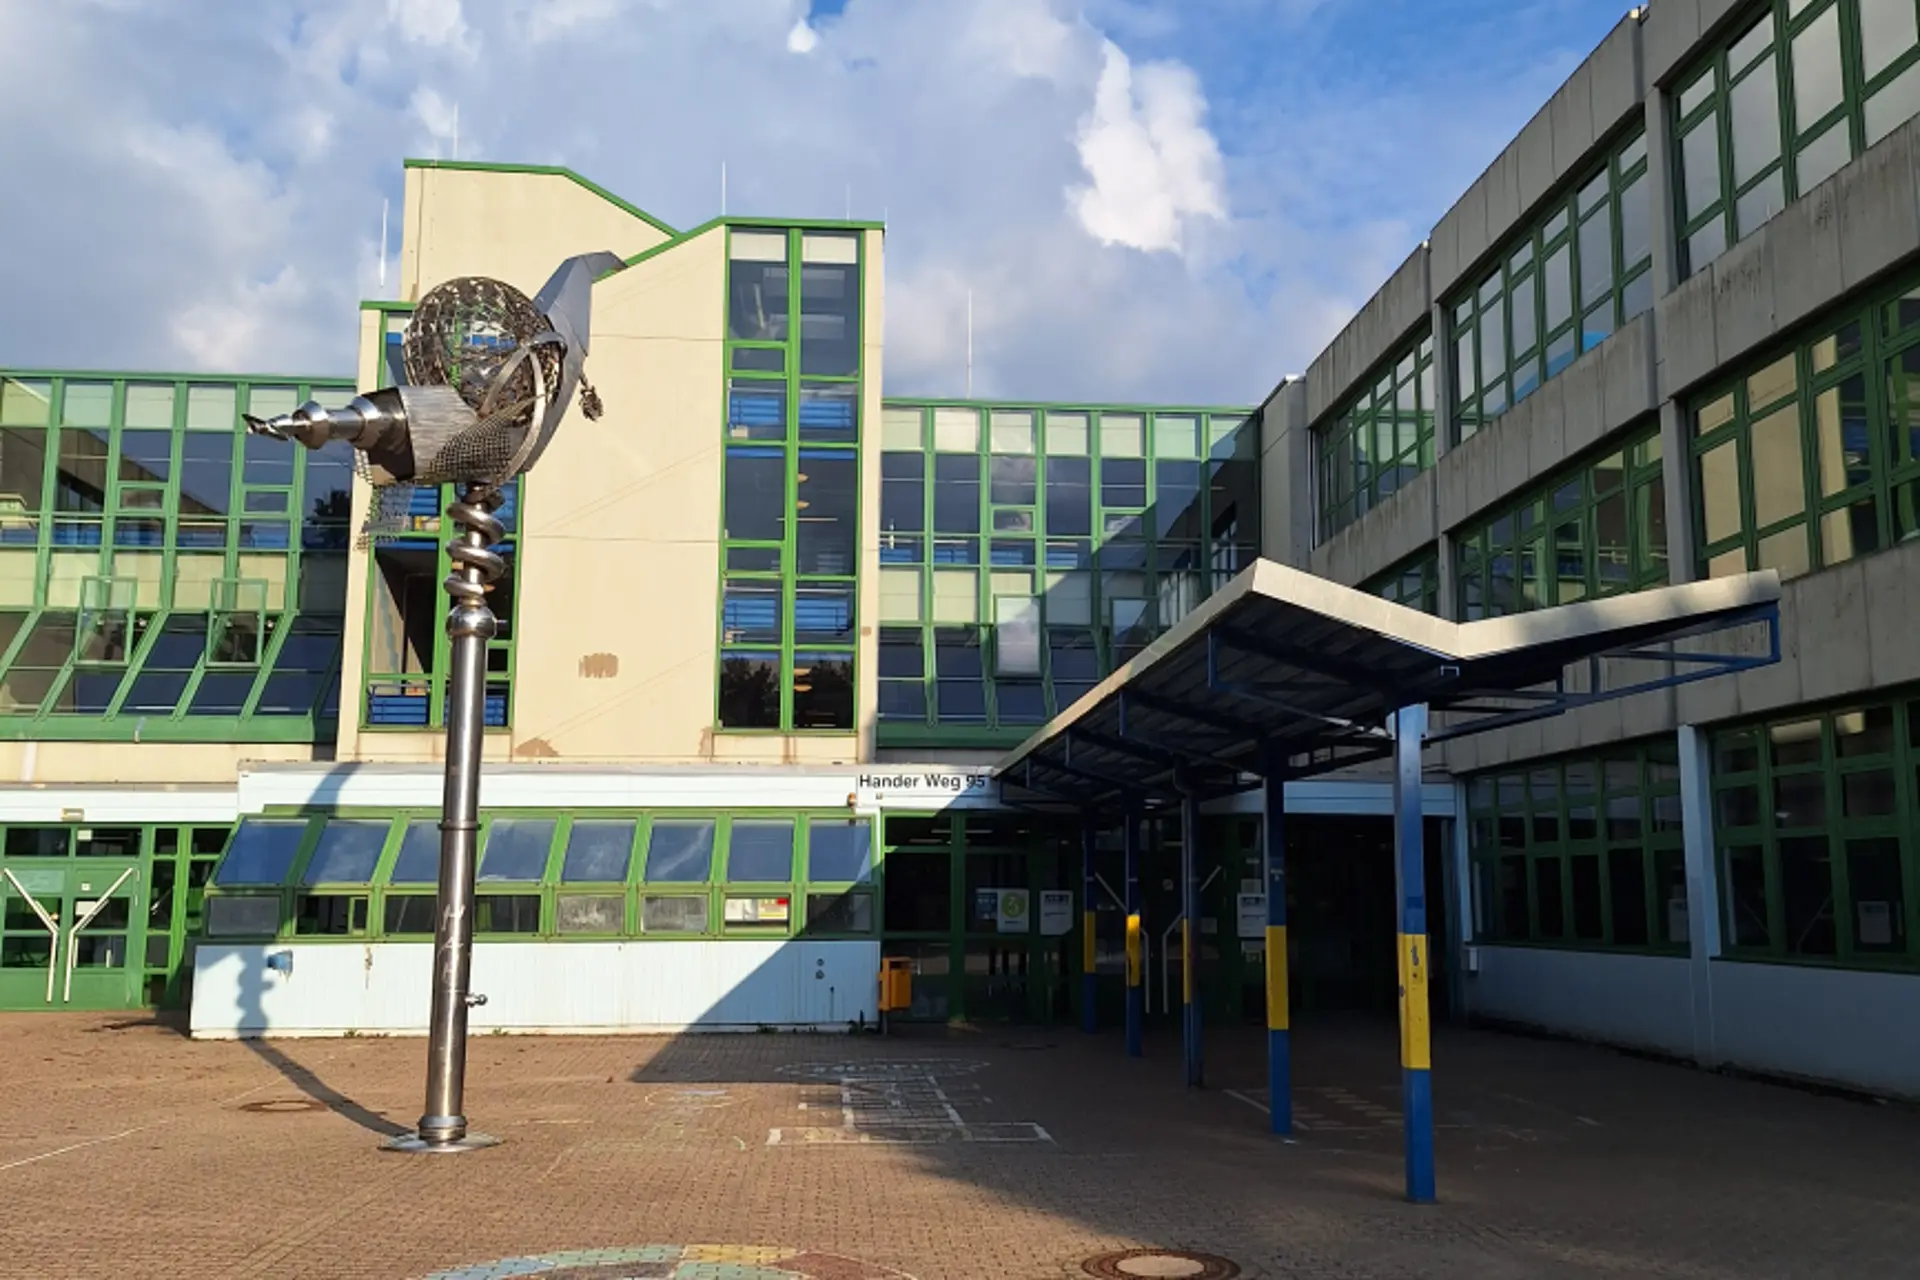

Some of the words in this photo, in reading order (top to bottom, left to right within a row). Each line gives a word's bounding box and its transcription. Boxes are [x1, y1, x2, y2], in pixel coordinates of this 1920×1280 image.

[859, 774, 920, 788] Hander
[924, 774, 961, 790] Weg
[966, 774, 985, 788] 95
